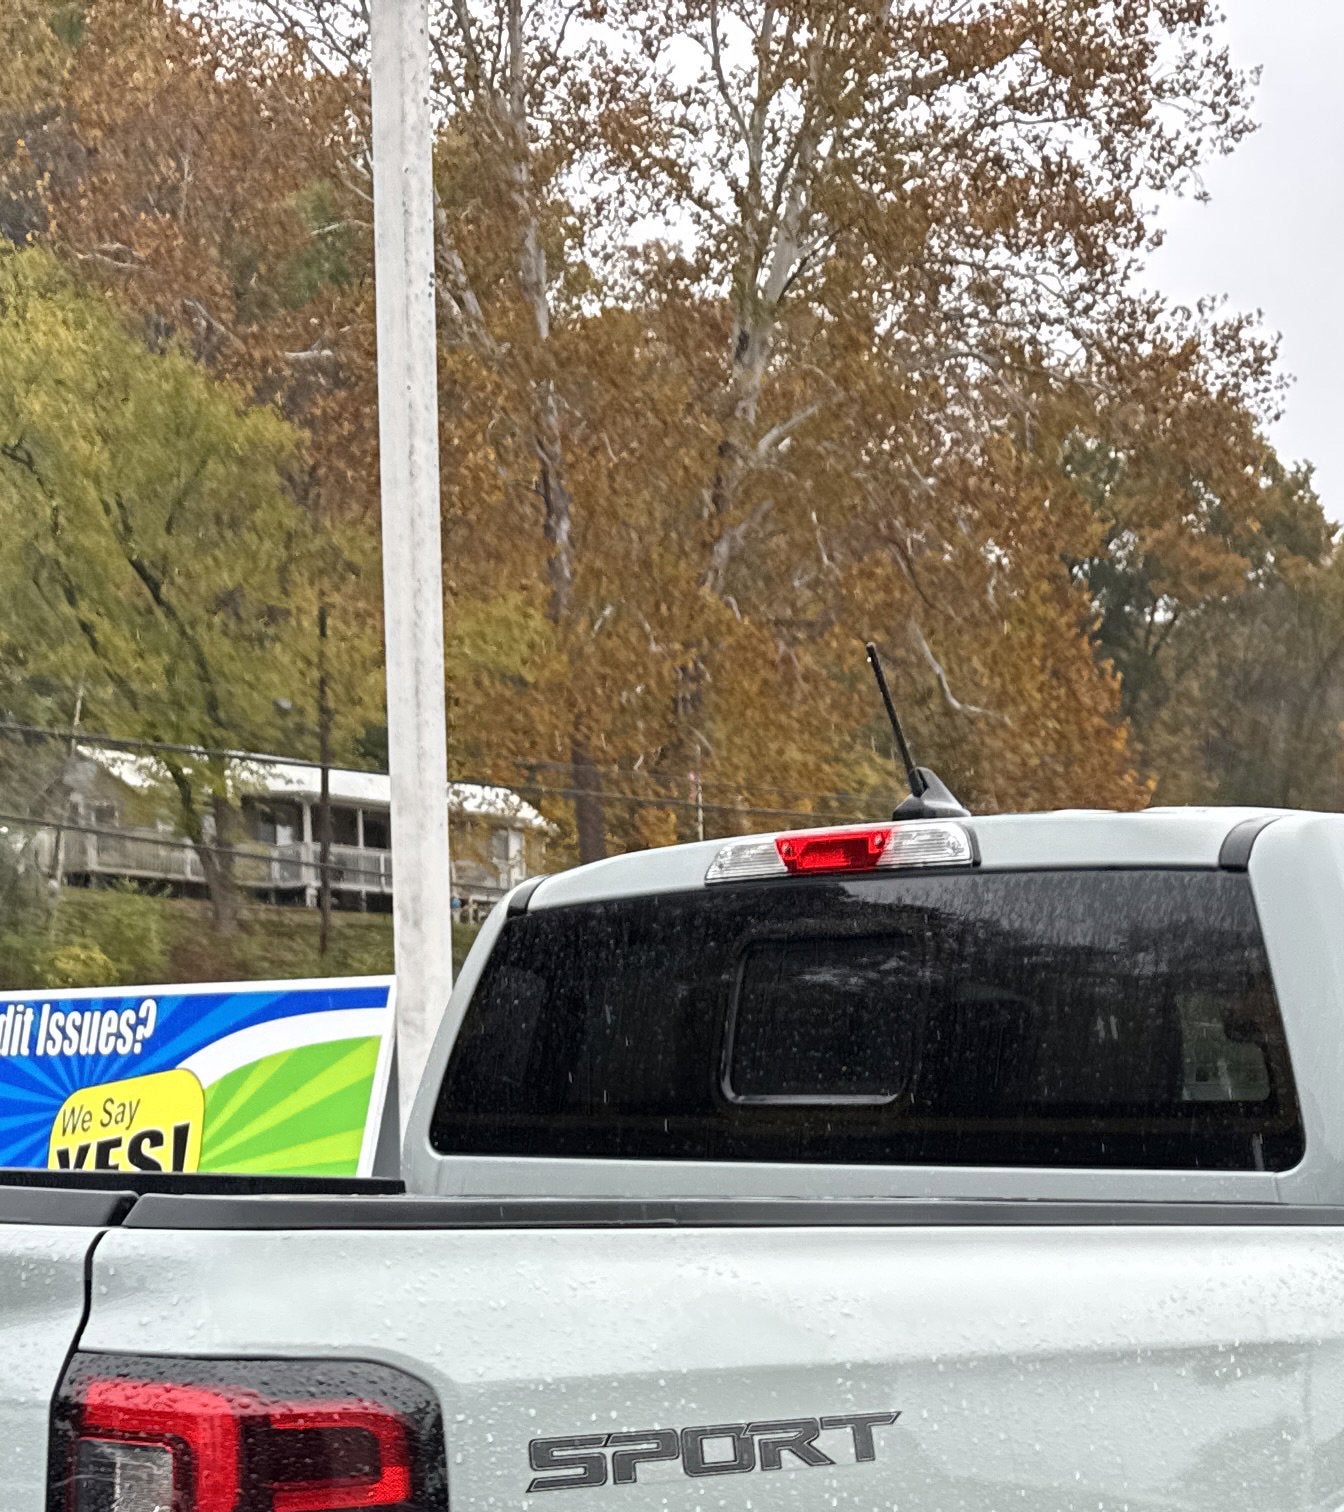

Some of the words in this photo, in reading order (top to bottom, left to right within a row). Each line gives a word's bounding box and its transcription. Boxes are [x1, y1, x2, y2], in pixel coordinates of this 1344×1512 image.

[36, 999, 157, 1056] Issues?
[62, 1105, 92, 1136] We
[100, 1097, 141, 1130] Say
[525, 1410, 902, 1493] SPORT
